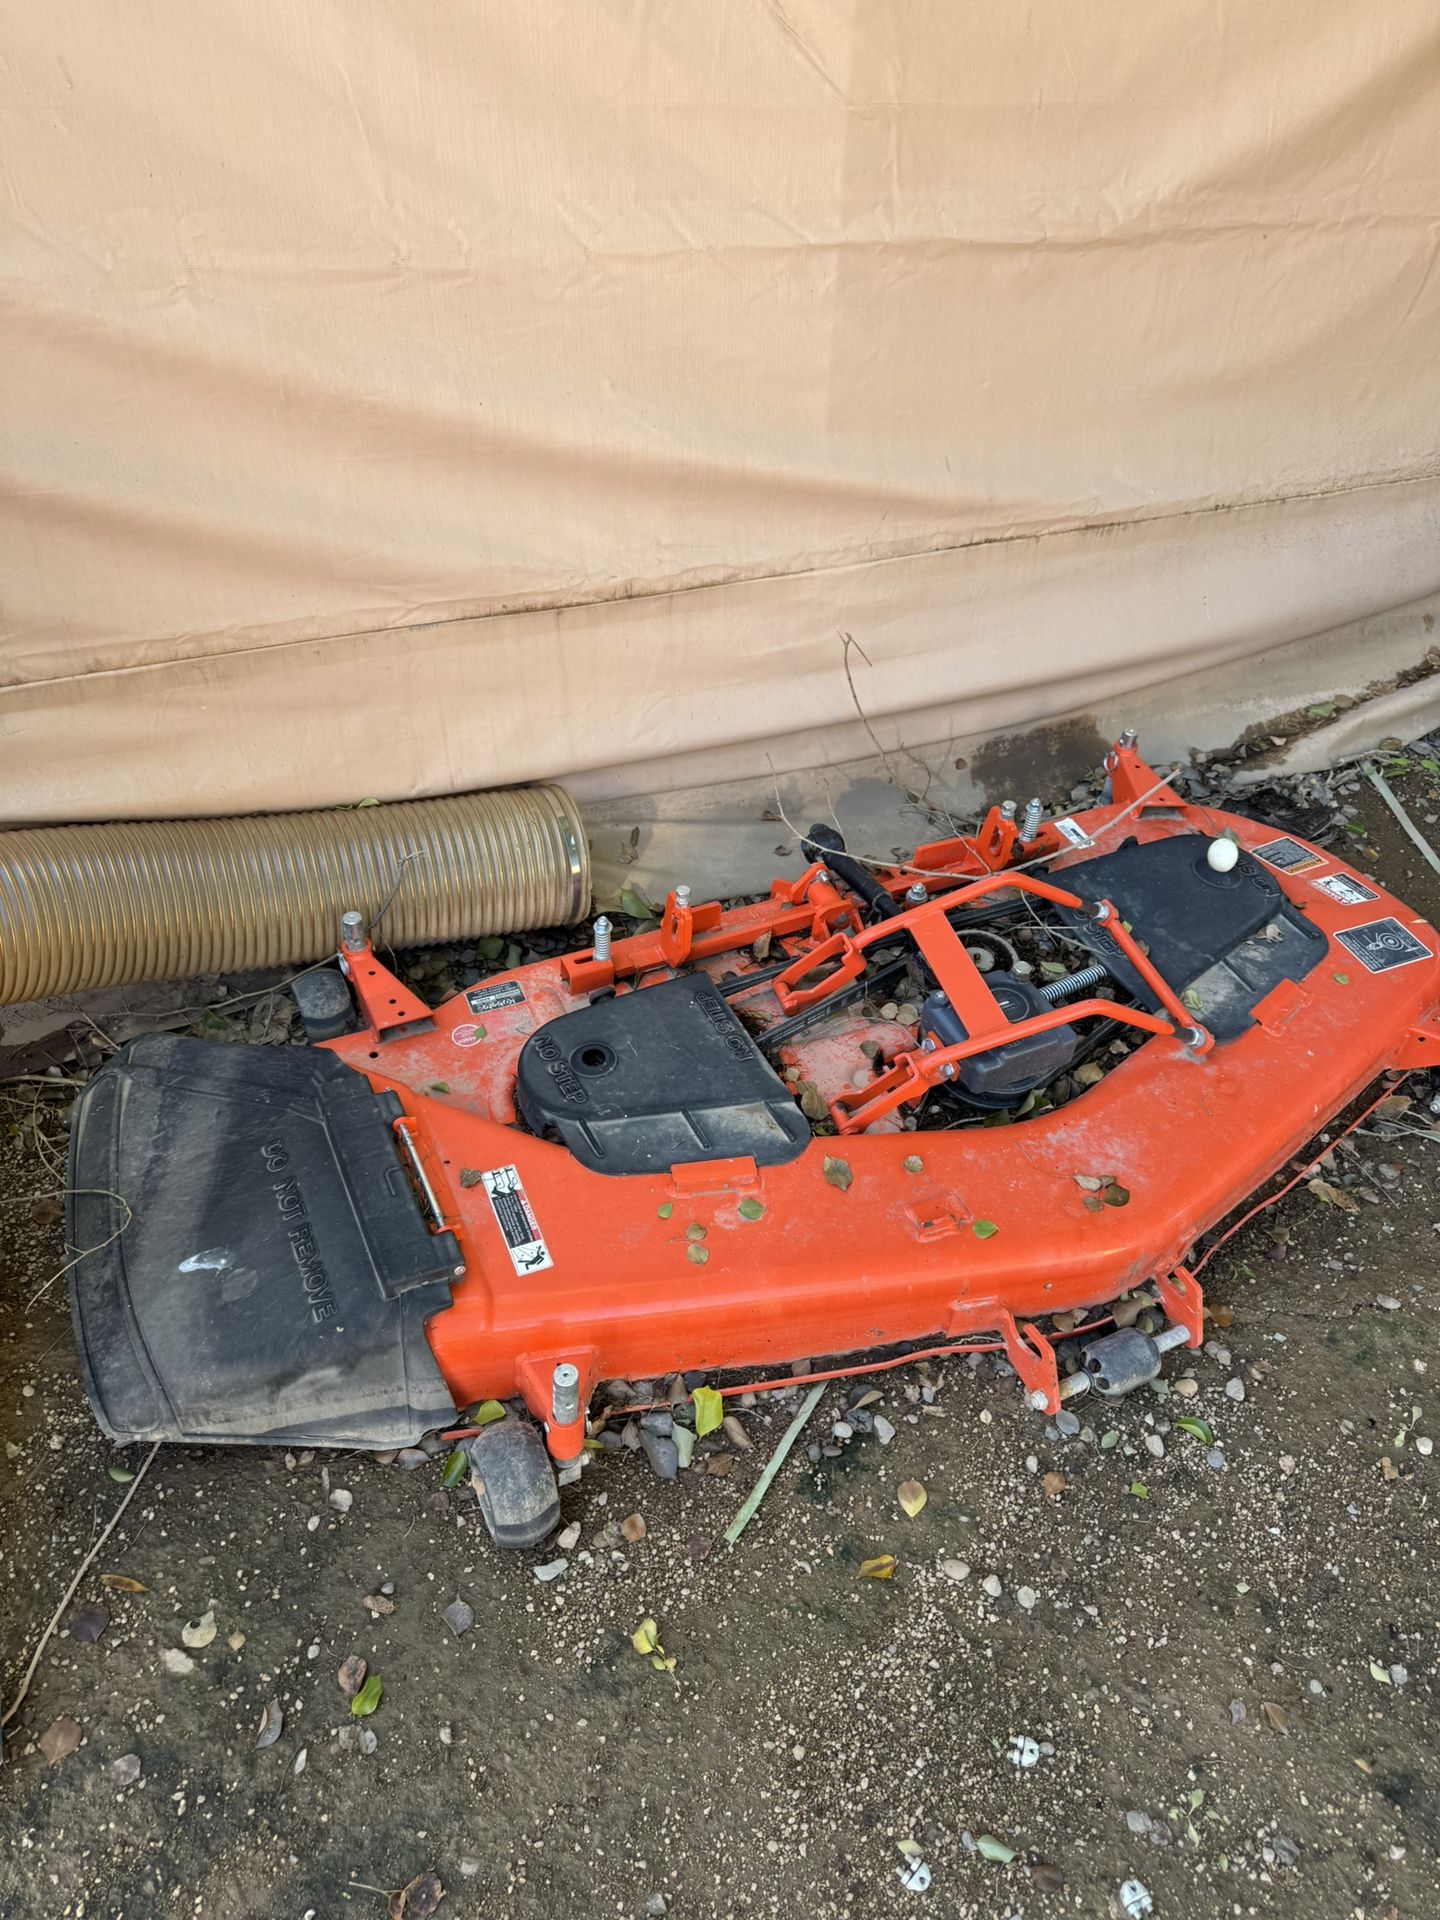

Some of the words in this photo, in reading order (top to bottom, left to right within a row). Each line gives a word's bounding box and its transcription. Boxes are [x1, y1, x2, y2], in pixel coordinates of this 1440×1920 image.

[1251, 876, 1281, 898] NO
[482, 998, 516, 1010] Kubota
[696, 991, 735, 1034] STEP
[725, 1035, 755, 1062] NO
[534, 1034, 561, 1062] NO
[548, 1060, 588, 1104] STEP
[260, 1137, 289, 1172] DO
[272, 1175, 308, 1221] NOT
[521, 1204, 538, 1232] DANGER
[288, 1222, 339, 1324] REMOVE
